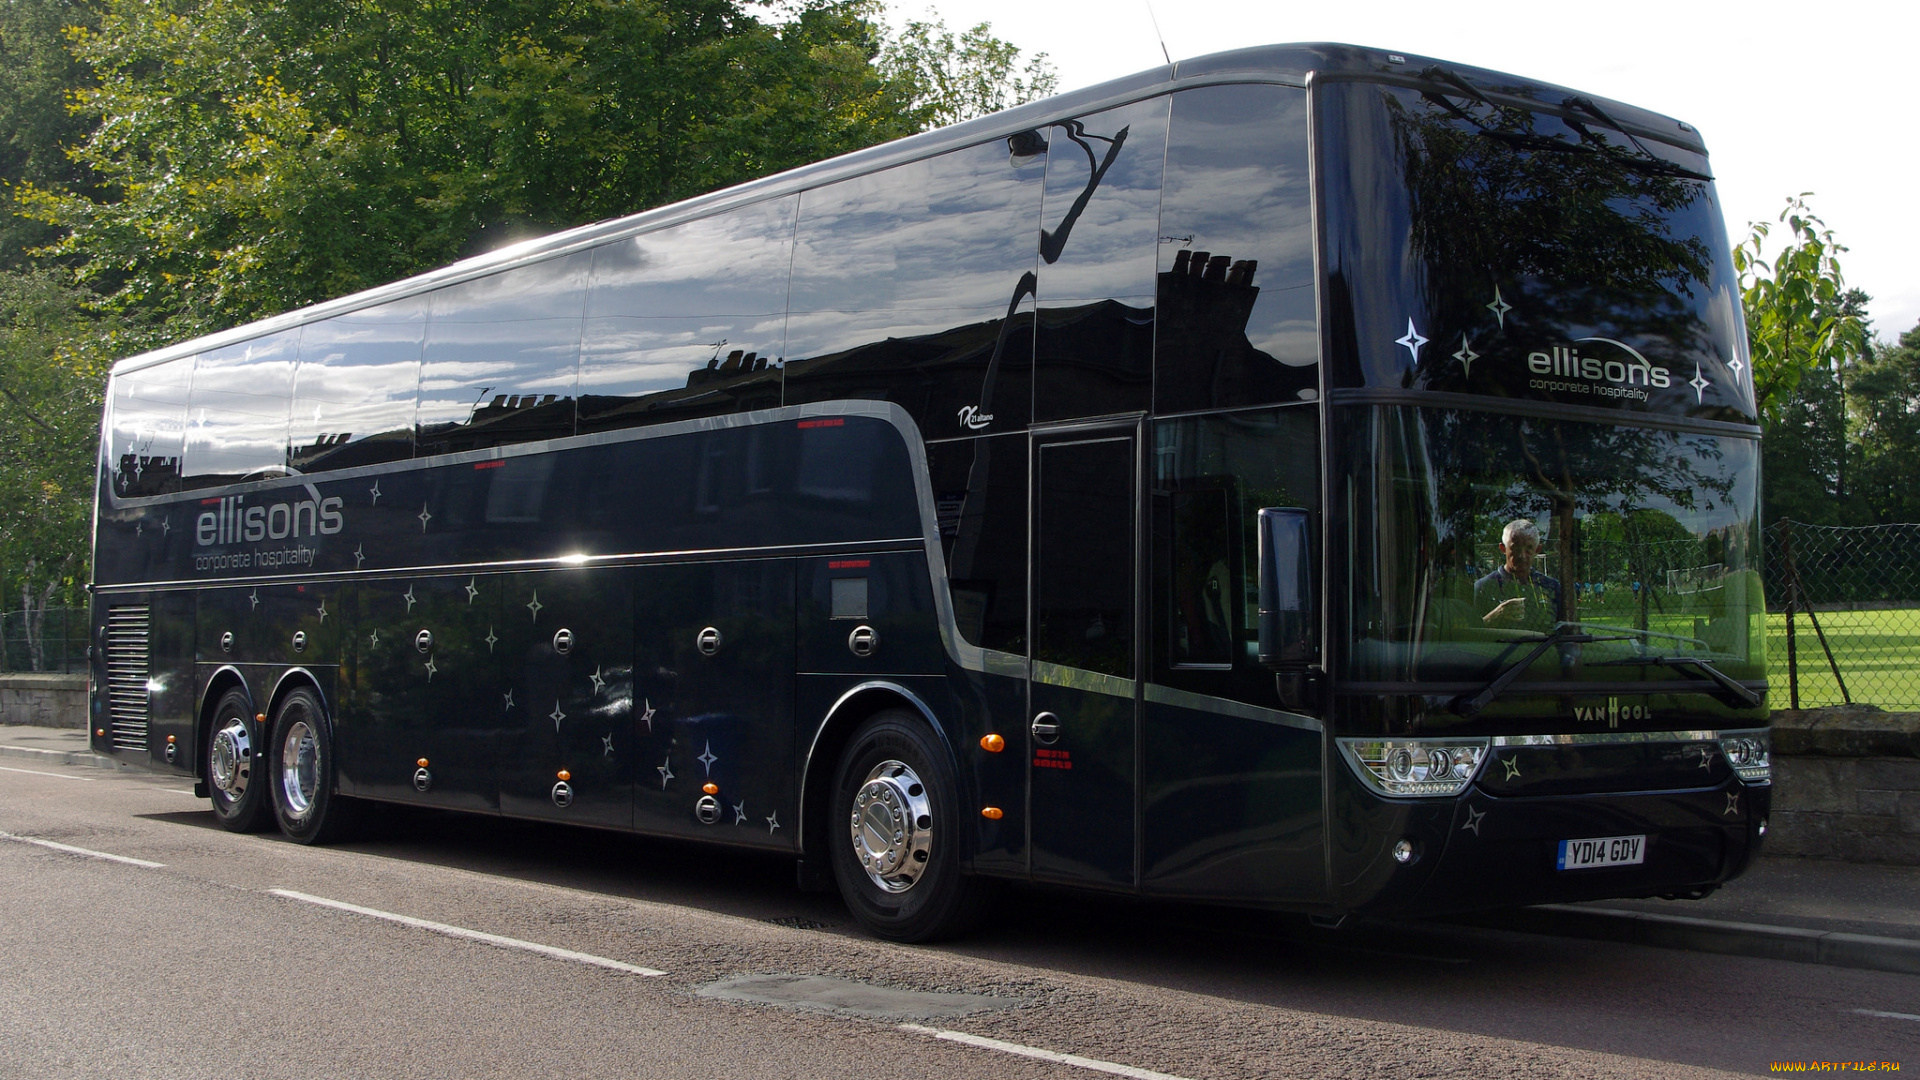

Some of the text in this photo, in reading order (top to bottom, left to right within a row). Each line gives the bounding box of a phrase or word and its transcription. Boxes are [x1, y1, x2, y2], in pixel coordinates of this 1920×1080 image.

[1527, 346, 1671, 388] ellisons
[1529, 379, 1649, 402] corporate hospitality
[197, 495, 343, 546] ellisons
[196, 545, 315, 573] corporate hospitality
[1572, 838, 1640, 864] YD14 GDV
